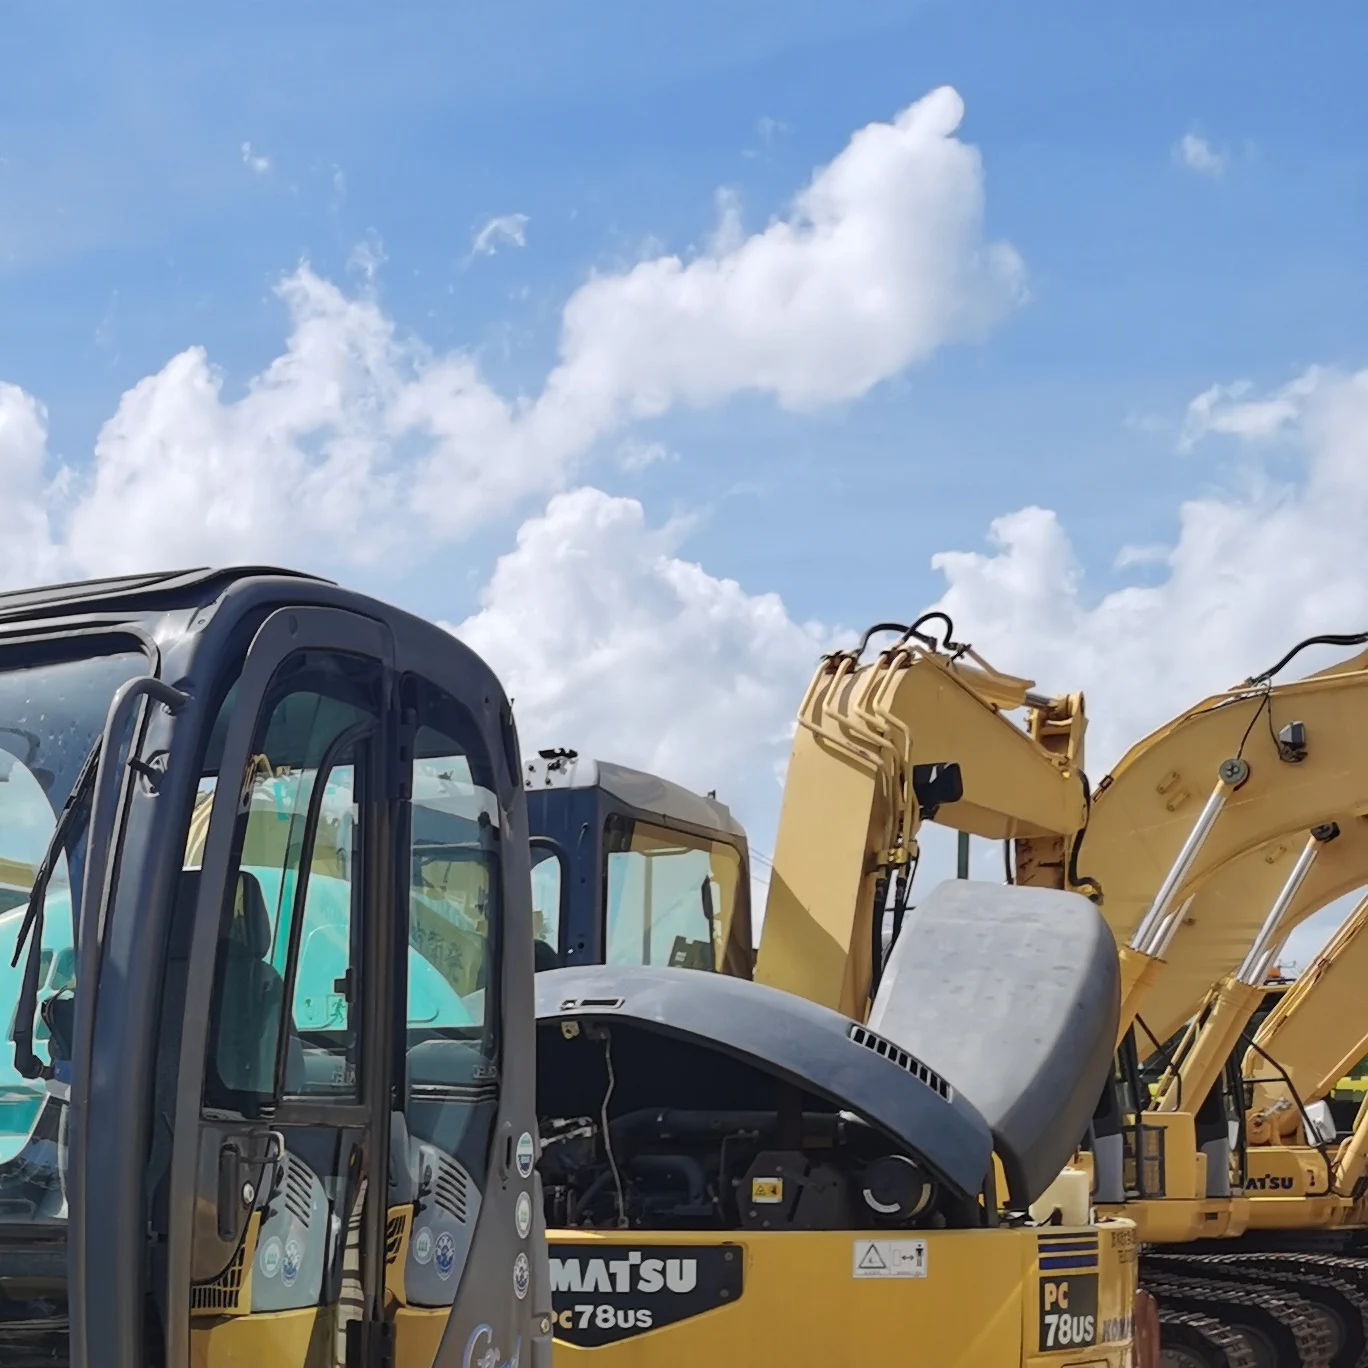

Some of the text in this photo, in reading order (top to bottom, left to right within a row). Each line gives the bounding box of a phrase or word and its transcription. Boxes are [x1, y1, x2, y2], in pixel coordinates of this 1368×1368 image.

[1245, 1173, 1293, 1190] ATSU
[548, 1251, 697, 1293] MATSU
[1044, 1282, 1069, 1311] PC
[1044, 1314, 1095, 1347] 78US
